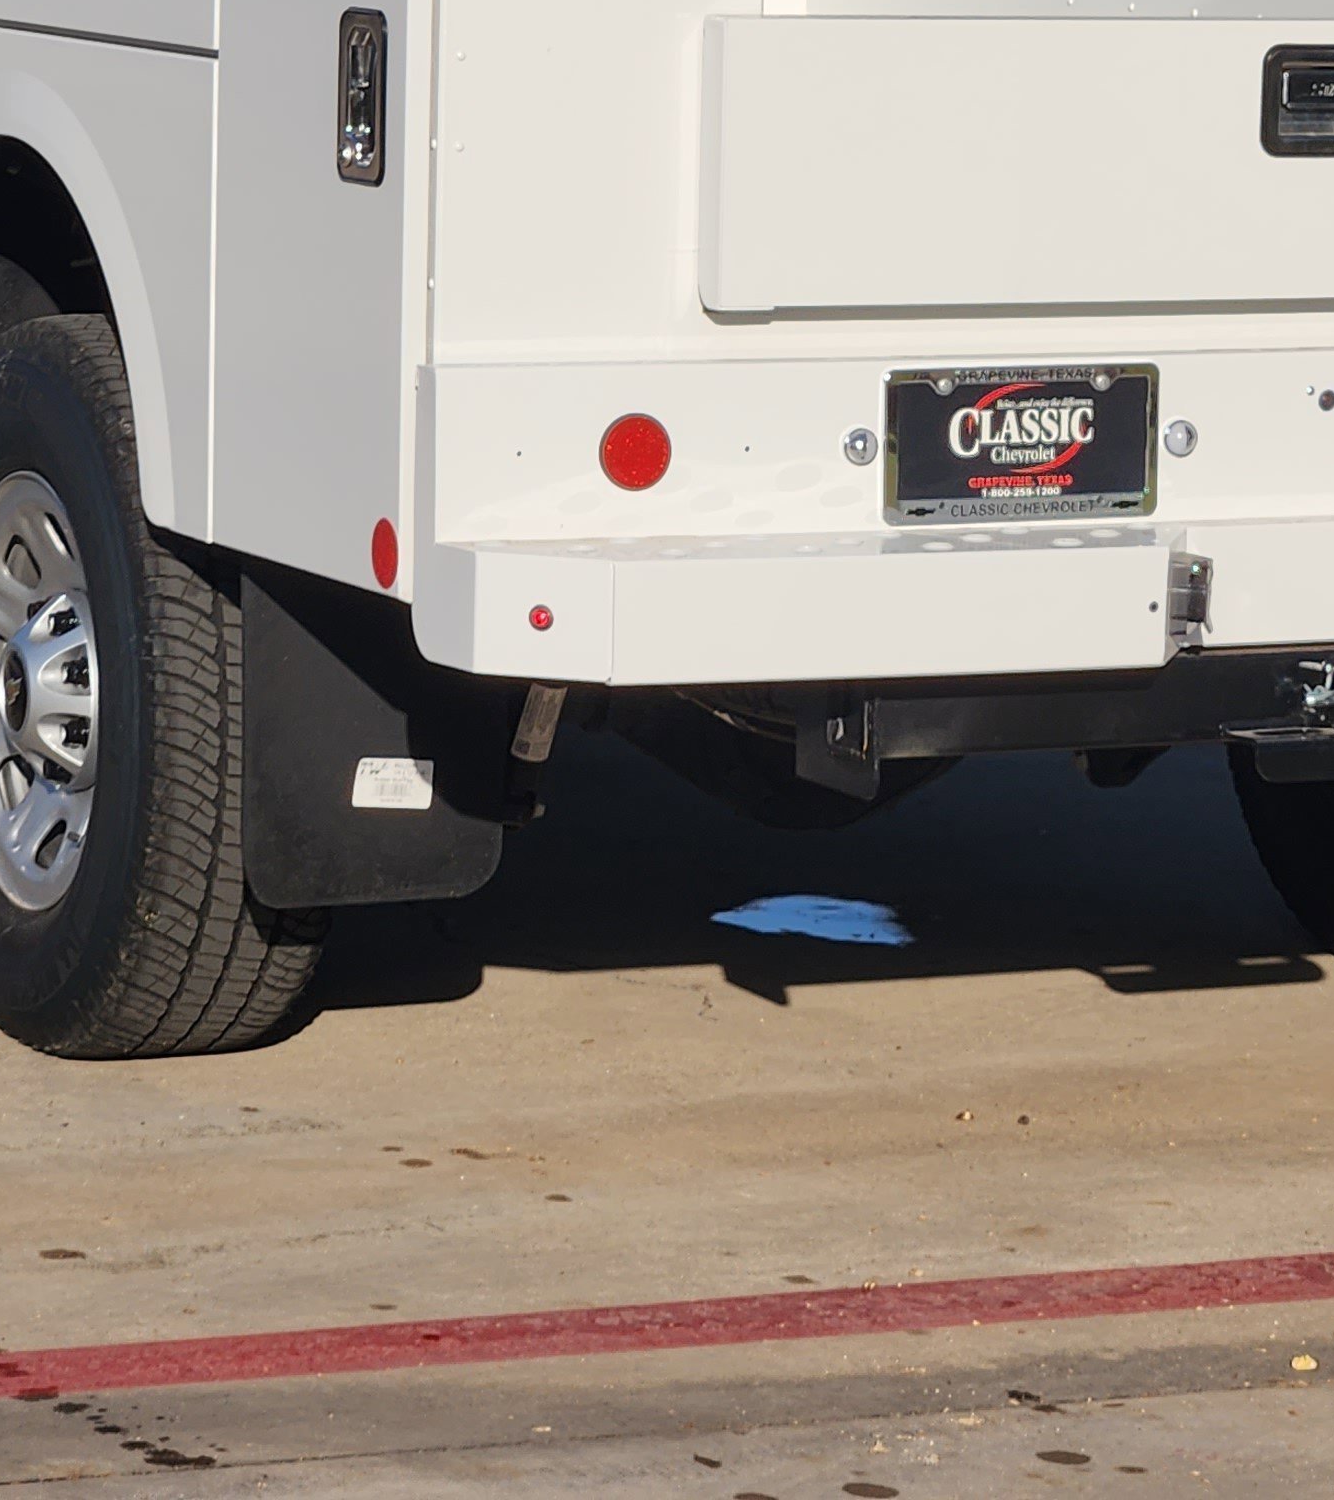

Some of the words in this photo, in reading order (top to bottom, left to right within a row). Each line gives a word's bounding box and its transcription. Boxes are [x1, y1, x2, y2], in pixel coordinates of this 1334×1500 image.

[1048, 367, 1092, 380] TEXAS
[949, 406, 1095, 459] CLASSIC
[991, 445, 1056, 464] Chevrolet
[1037, 474, 1073, 486] TEXAS
[951, 502, 1009, 518] CLASSIC
[1014, 499, 1095, 515] CHEVROLET
